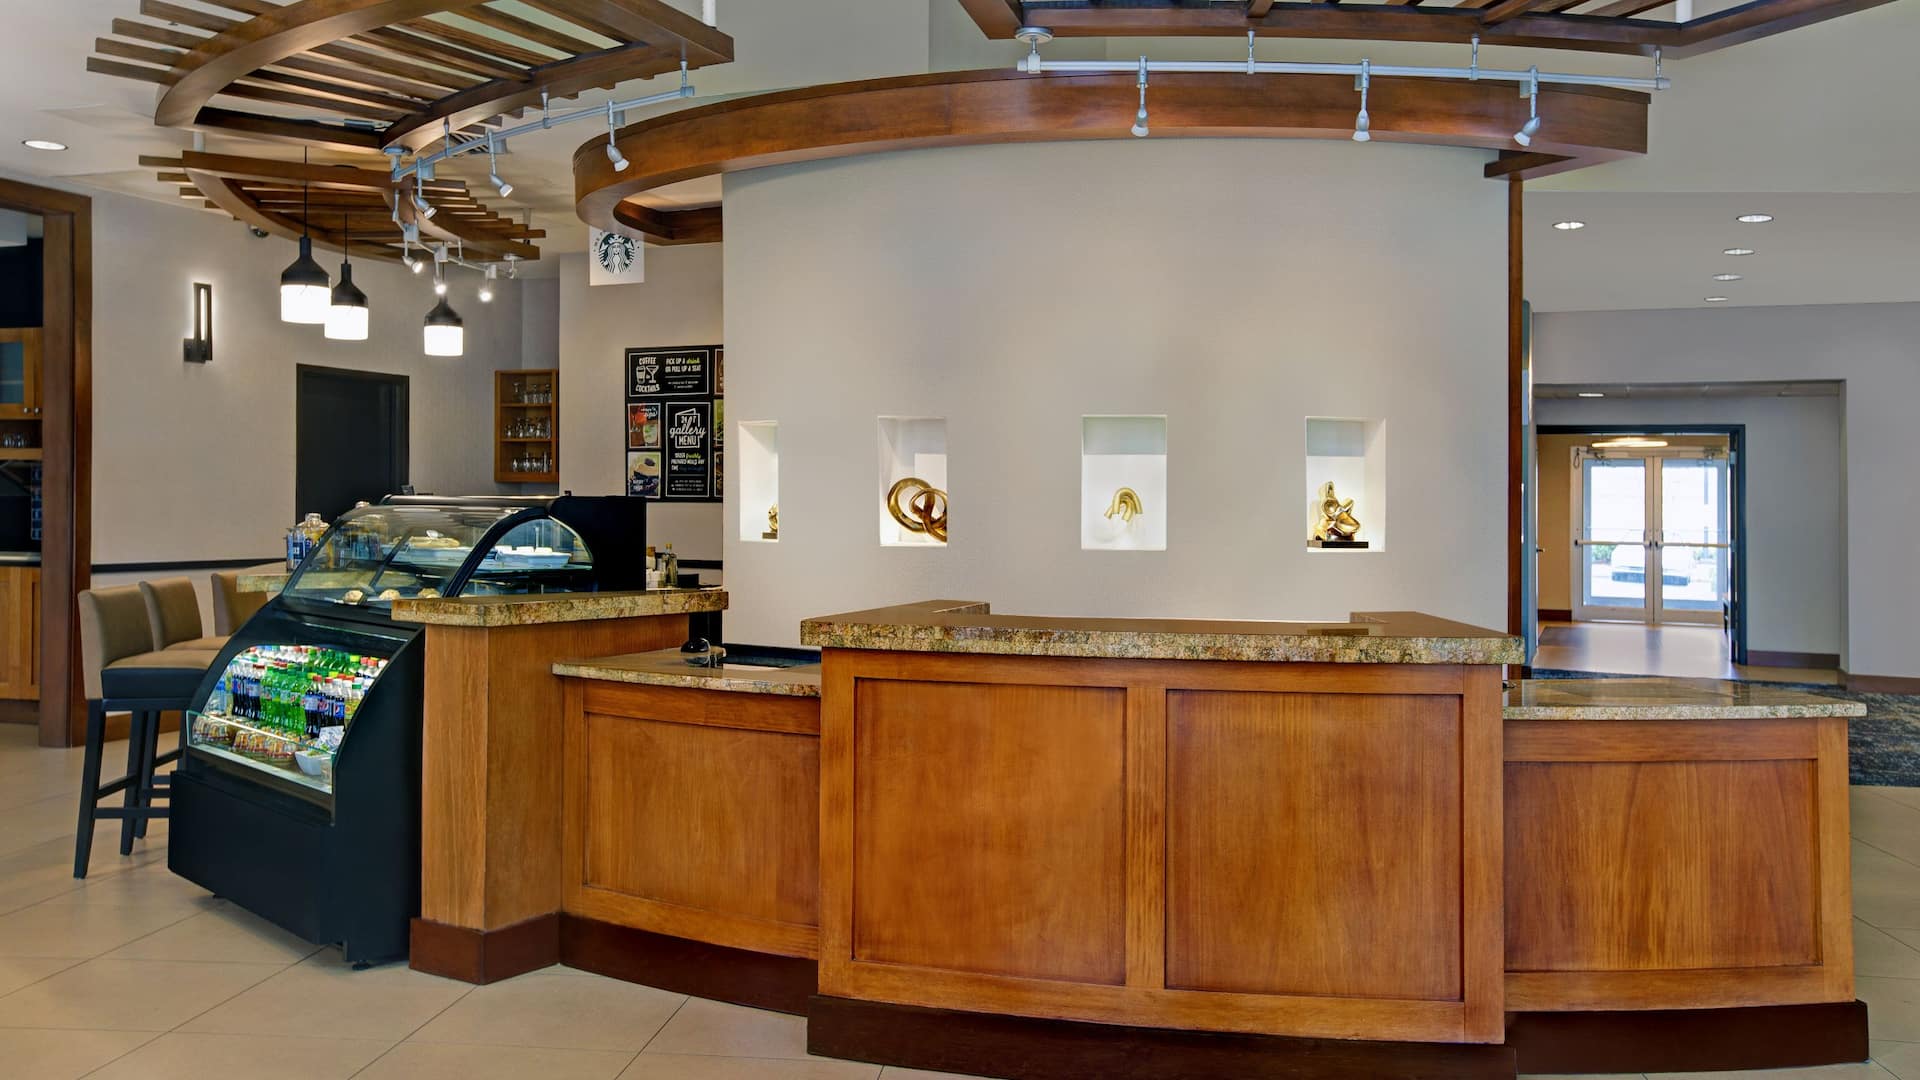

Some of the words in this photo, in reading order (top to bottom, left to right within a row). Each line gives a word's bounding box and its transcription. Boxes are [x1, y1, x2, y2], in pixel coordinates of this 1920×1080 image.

[638, 356, 657, 365] COFFEE
[676, 357, 682, 365] UP
[672, 365, 681, 373] PULL
[692, 364, 702, 372] SEAT
[635, 383, 660, 393] COCKTAILS
[669, 418, 706, 439] gallery
[678, 435, 697, 445] MENU
